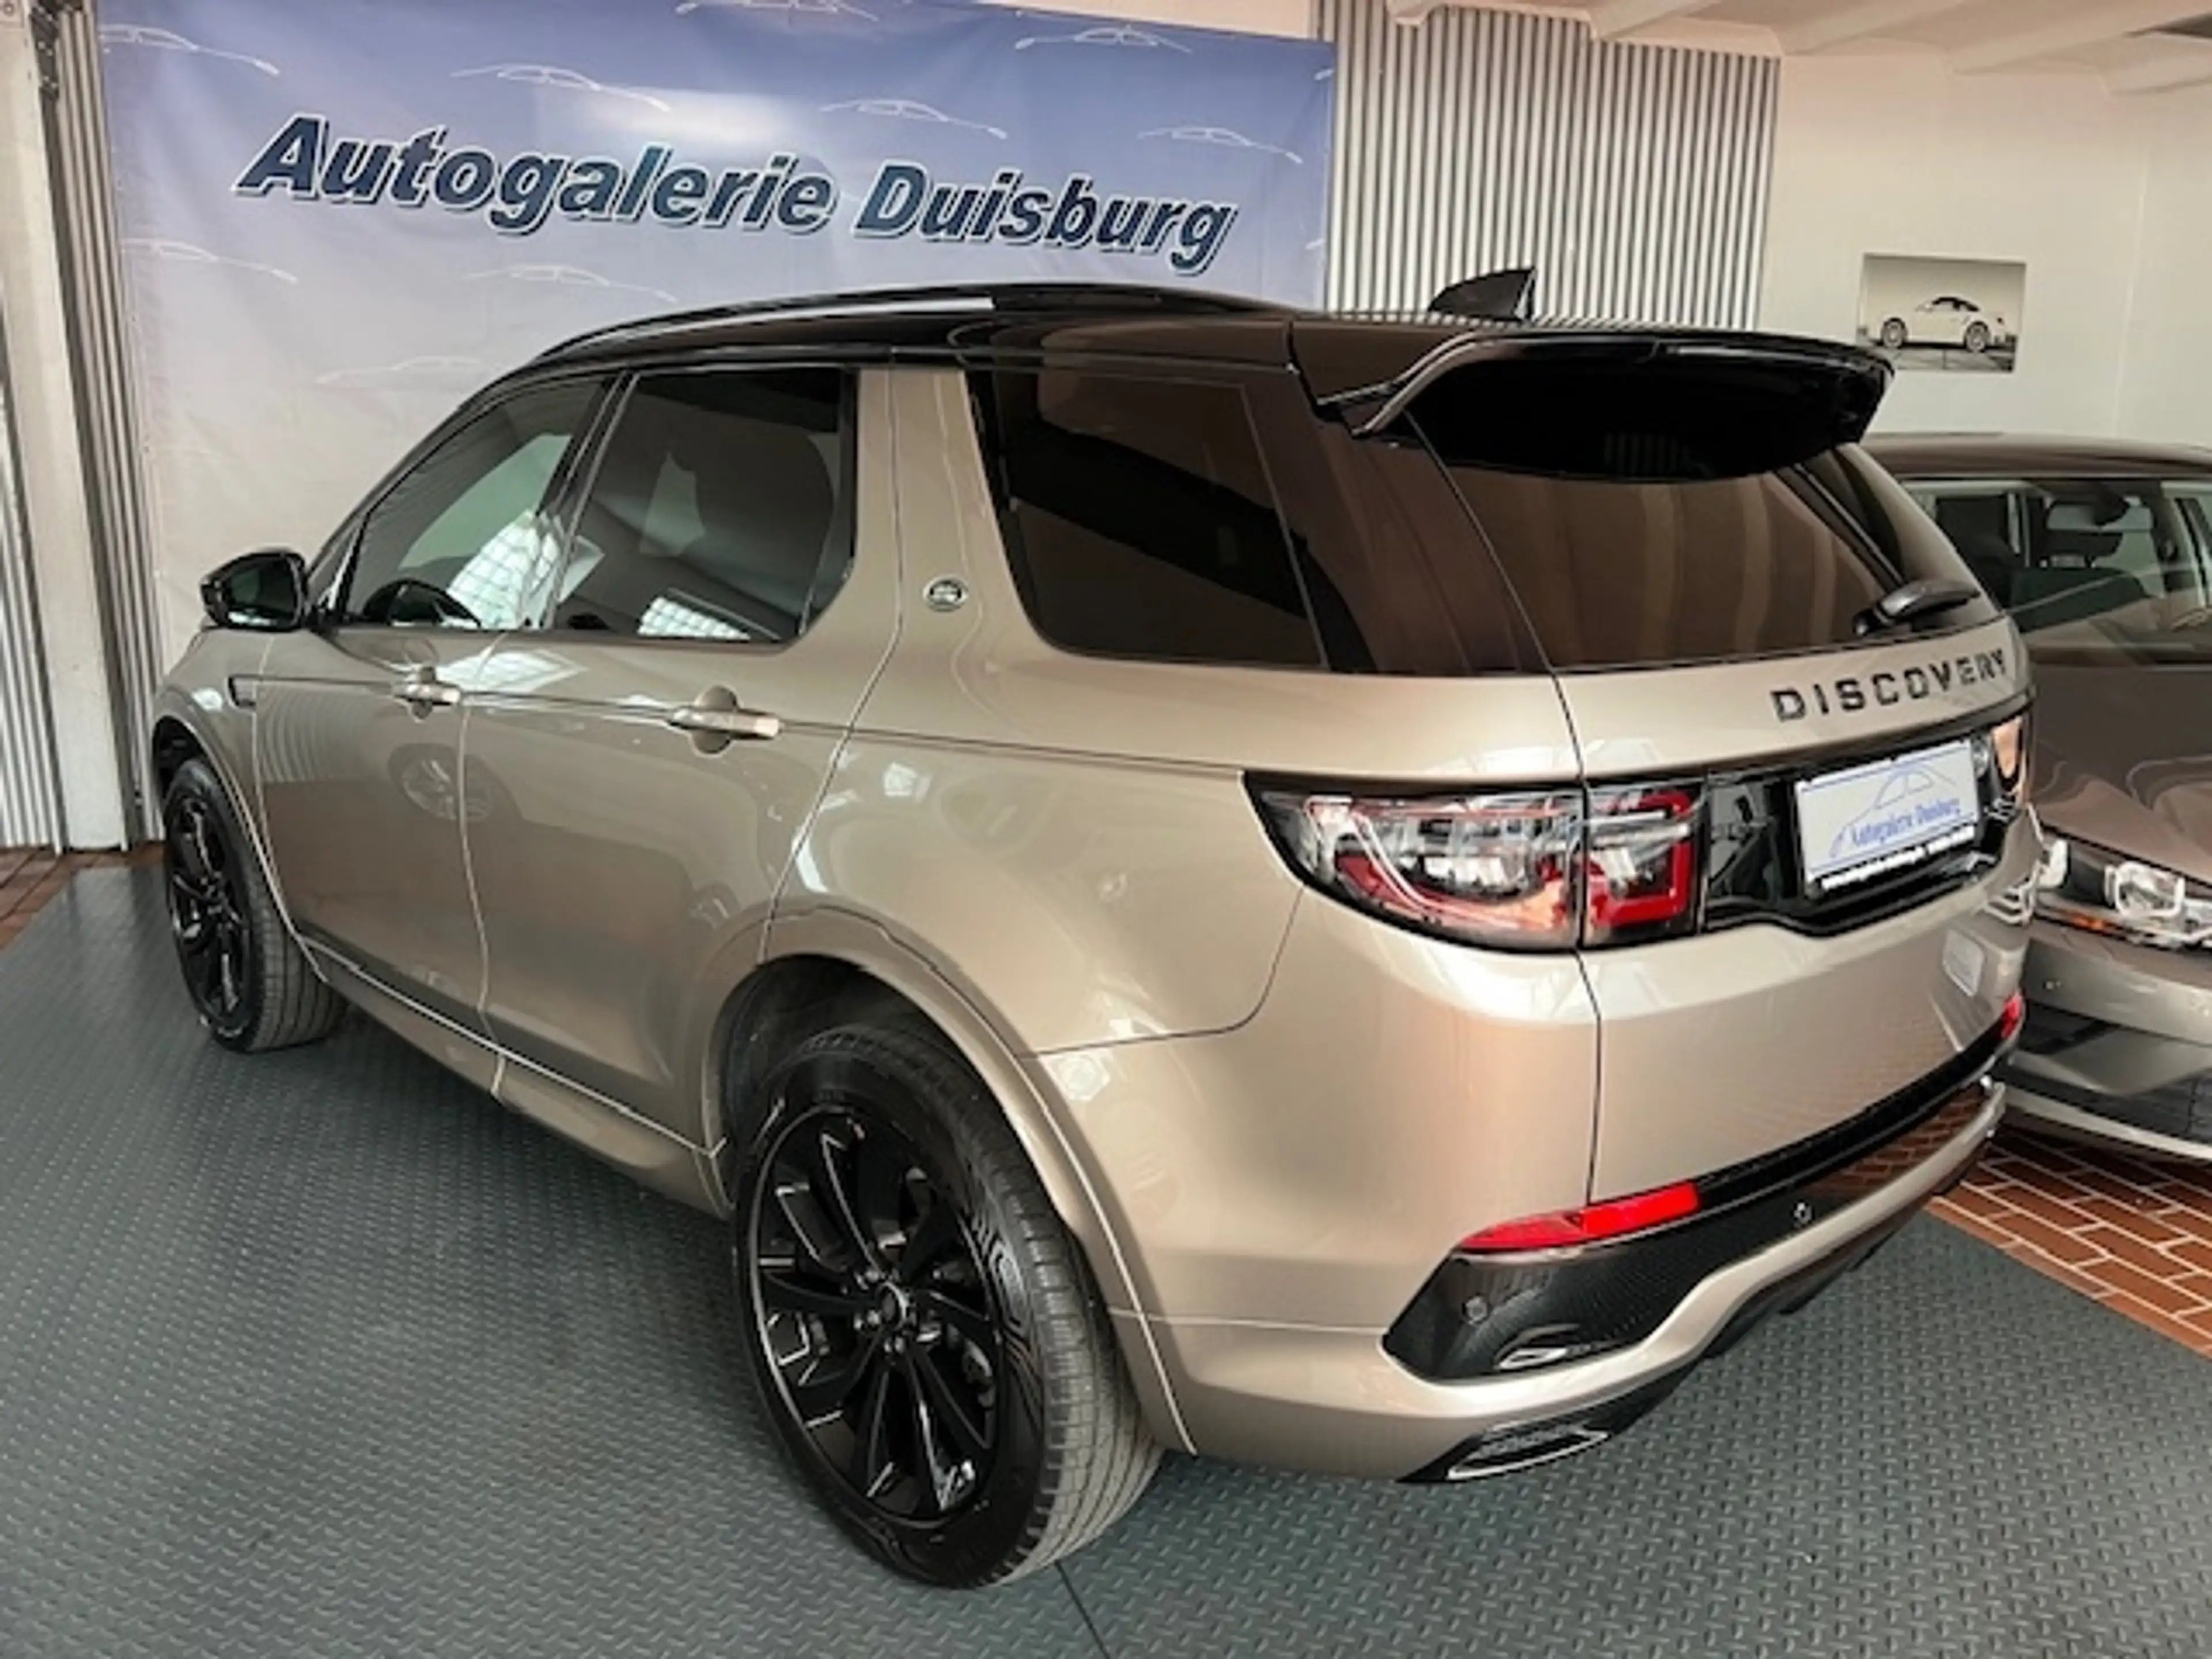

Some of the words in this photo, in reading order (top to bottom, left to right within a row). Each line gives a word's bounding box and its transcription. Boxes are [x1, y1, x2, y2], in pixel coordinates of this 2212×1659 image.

[235, 114, 835, 236] Autogalerie
[854, 162, 1239, 274] Duisburg
[1770, 649, 2006, 722] DISCOVERY
